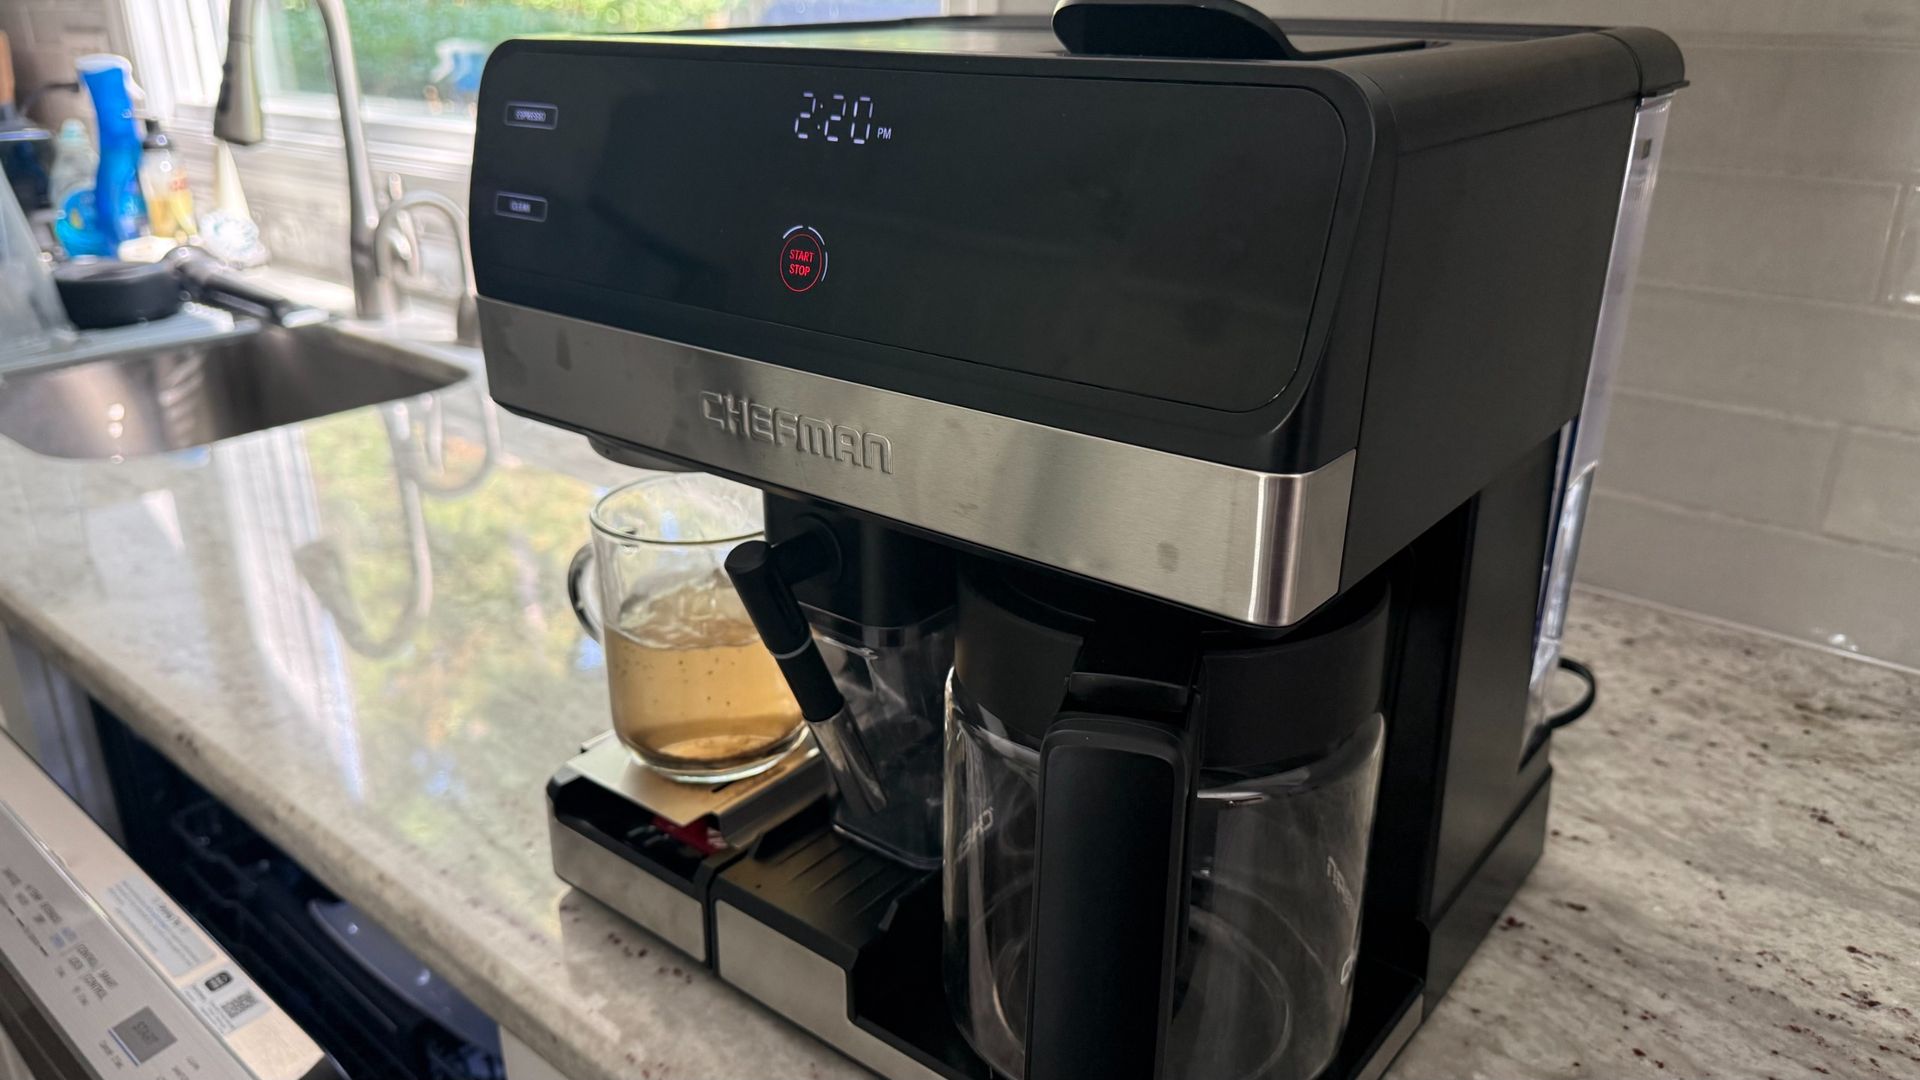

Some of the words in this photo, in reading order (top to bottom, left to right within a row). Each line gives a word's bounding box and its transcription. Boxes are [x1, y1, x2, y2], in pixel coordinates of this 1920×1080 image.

[794, 92, 873, 144] 2:20
[877, 127, 892, 140] PM
[789, 249, 815, 262] START
[789, 263, 811, 276] STOP
[701, 390, 893, 474] CHEFMAN
